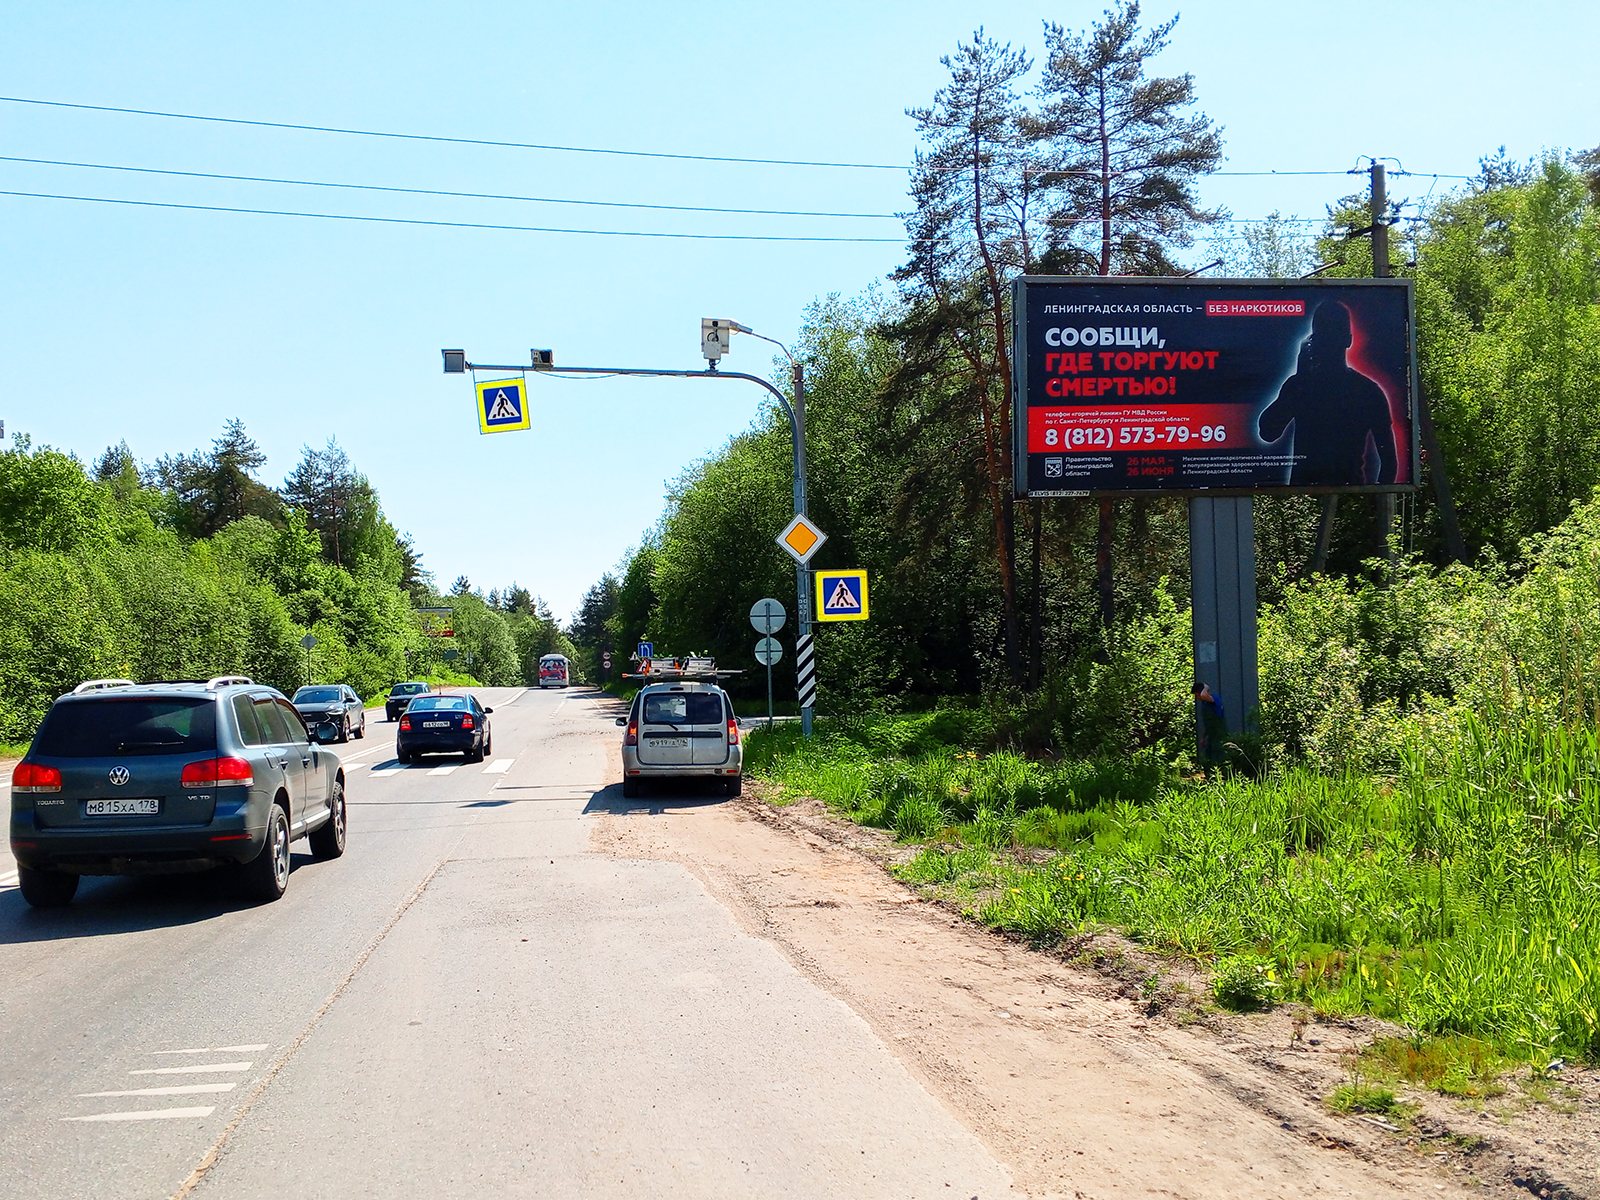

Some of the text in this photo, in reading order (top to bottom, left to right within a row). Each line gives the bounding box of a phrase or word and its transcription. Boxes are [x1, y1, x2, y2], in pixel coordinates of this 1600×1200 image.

[1044, 304, 1140, 314] ЛЕНИНГРАДСКАЯ
[1143, 304, 1193, 313] ОБЛАСТЬ
[1208, 304, 1229, 313] БЕЗ
[1231, 304, 1303, 313] НАРКОТИКОВ
[1045, 327, 1166, 349] СООБЩИ,
[1045, 351, 1220, 375] ГДЕ ТОРГУЮТ
[1045, 376, 1177, 397] СМЕРТЬЮ!
[1045, 425, 1227, 450] 8 (812) 573-79-96
[1127, 458, 1140, 466] 26
[1141, 457, 1165, 465] МАЯ
[1127, 467, 1174, 476] 26 ИЮНЯ
[89, 800, 156, 813] М815ХА 178
